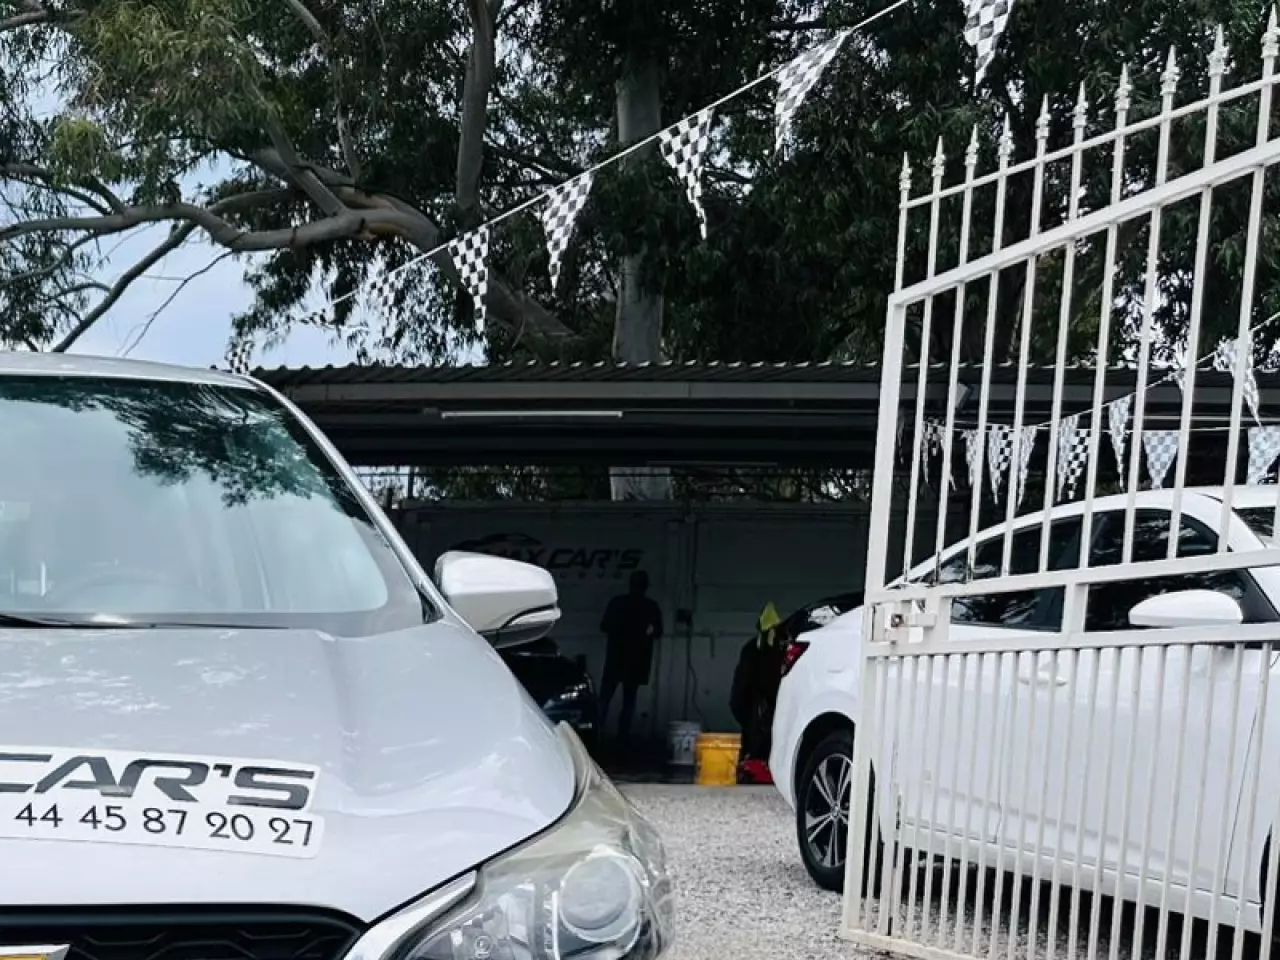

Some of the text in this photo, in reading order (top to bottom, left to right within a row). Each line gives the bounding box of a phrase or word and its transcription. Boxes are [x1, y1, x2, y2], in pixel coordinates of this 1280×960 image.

[14, 802, 63, 828] 44
[79, 805, 128, 832] 45
[142, 807, 188, 836] 87
[205, 811, 255, 841] 20
[268, 817, 314, 846] 27
